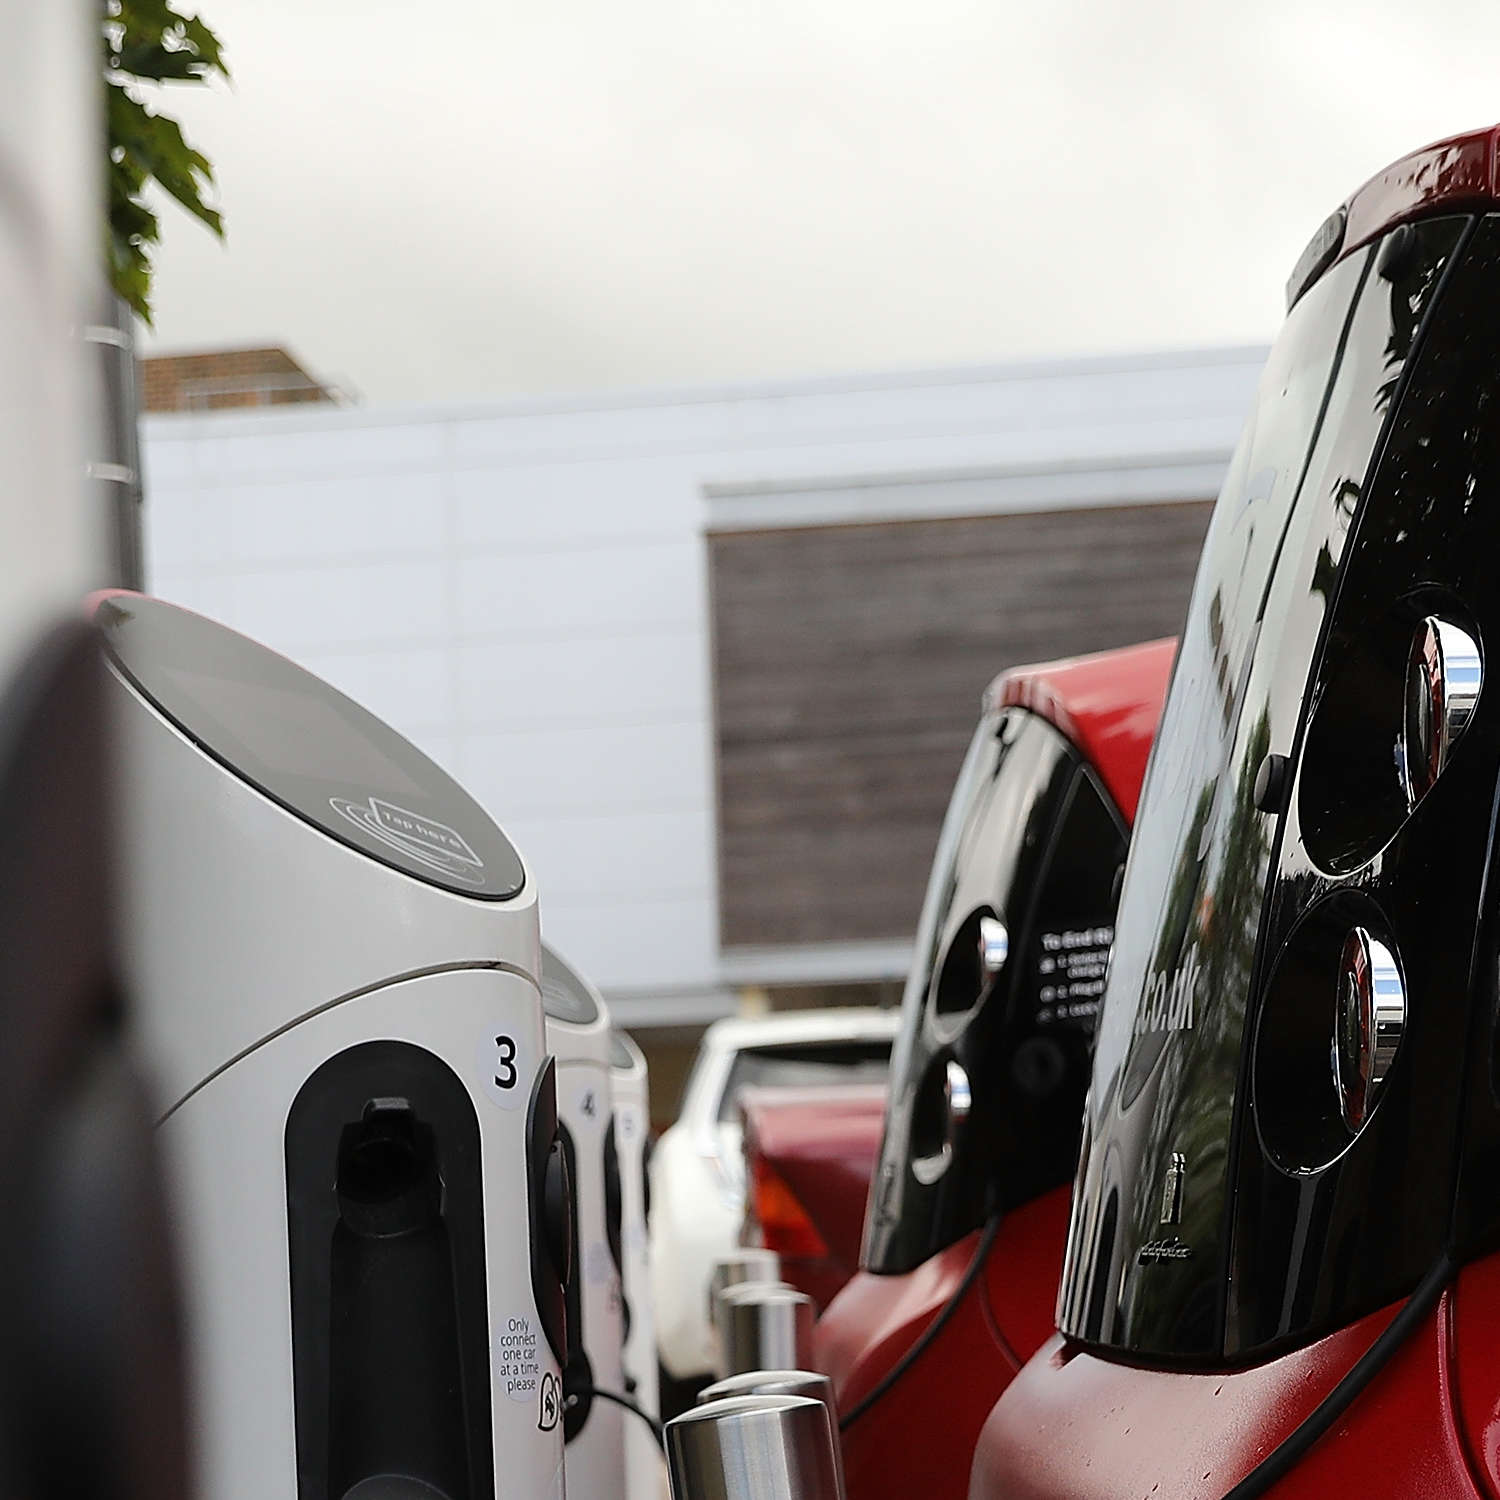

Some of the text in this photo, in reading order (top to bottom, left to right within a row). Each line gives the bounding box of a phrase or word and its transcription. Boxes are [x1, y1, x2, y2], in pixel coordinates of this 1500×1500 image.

[382, 810, 463, 850] Tap here
[493, 1034, 518, 1090] 3
[508, 1317, 530, 1335] Only
[500, 1334, 537, 1347] connect
[502, 1348, 536, 1361] one car
[500, 1361, 539, 1376] at a time
[507, 1377, 536, 1395] please
